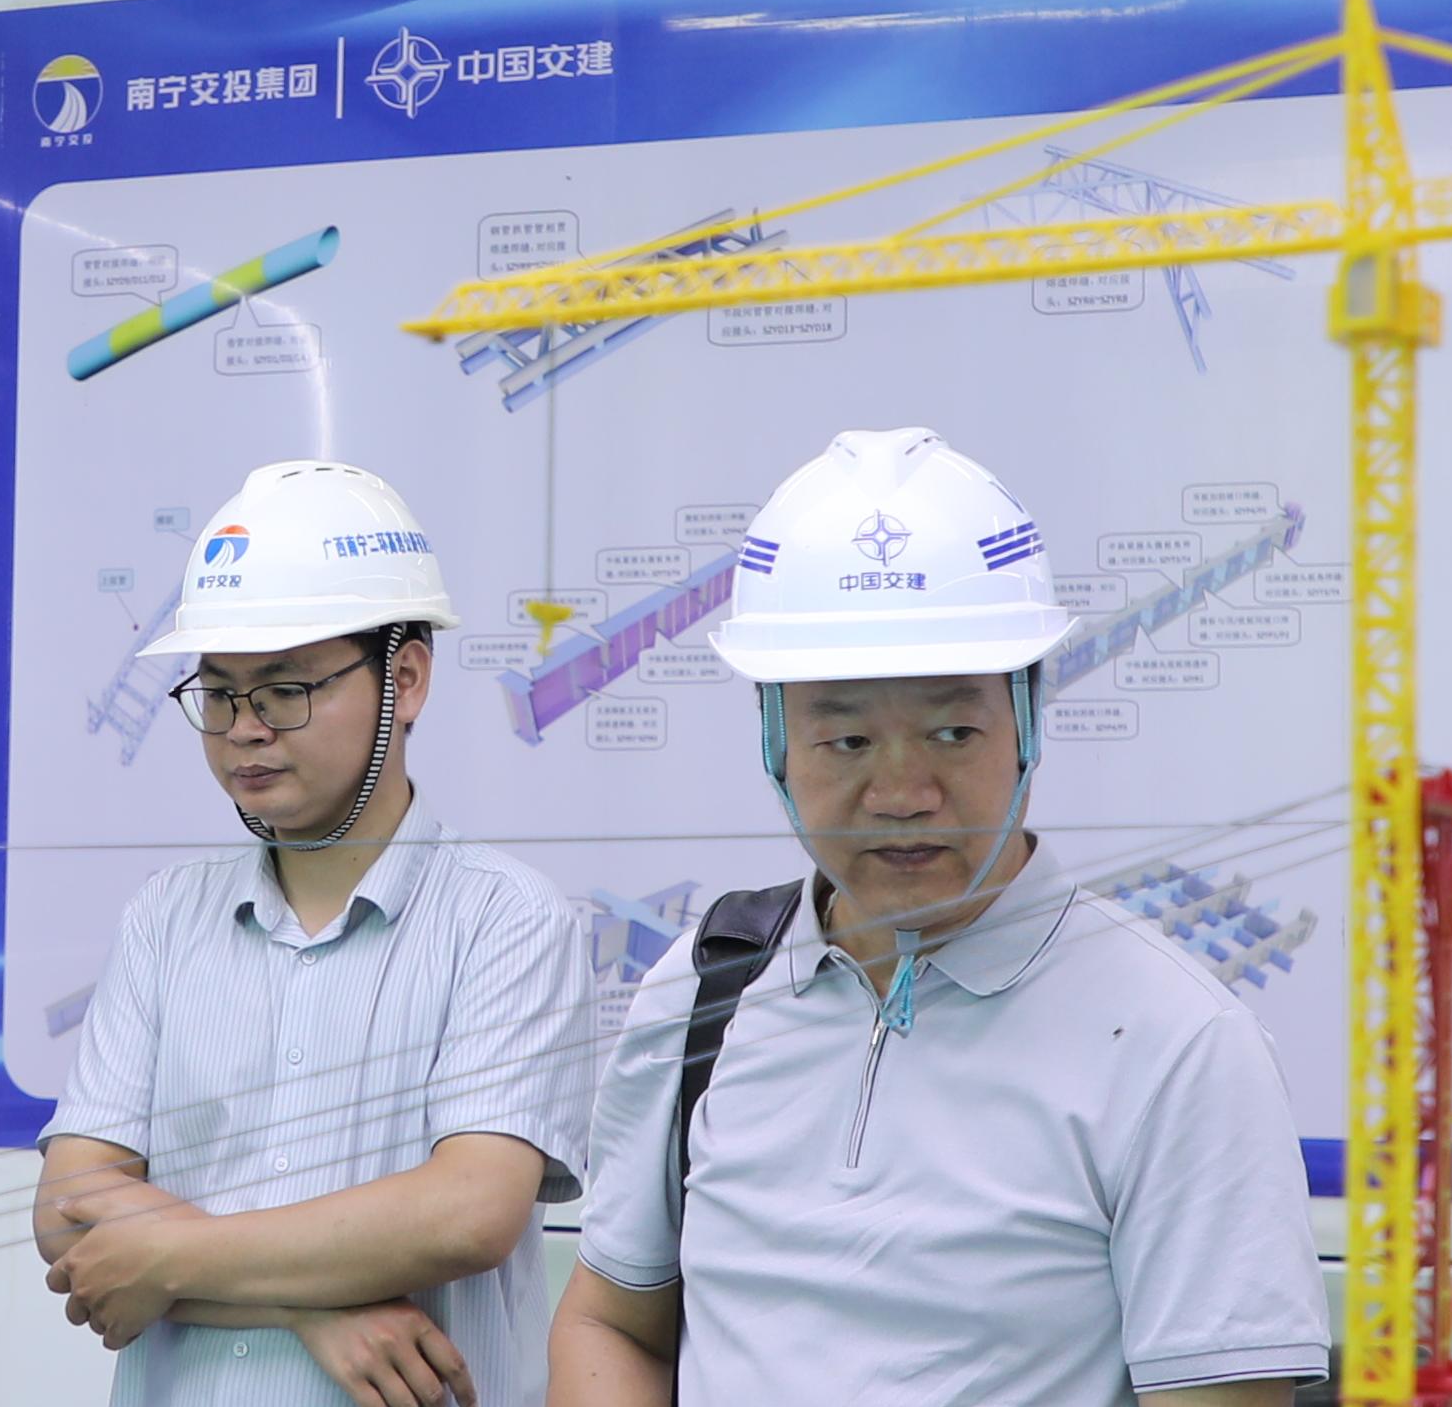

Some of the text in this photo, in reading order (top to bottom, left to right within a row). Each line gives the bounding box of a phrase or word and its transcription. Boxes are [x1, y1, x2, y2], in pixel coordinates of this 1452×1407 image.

[126, 41, 616, 112] 南宁交投集团 中国交建
[40, 133, 94, 148] 南宁交投
[197, 574, 243, 590] 南宁交投
[838, 571, 927, 592] 中国交建
